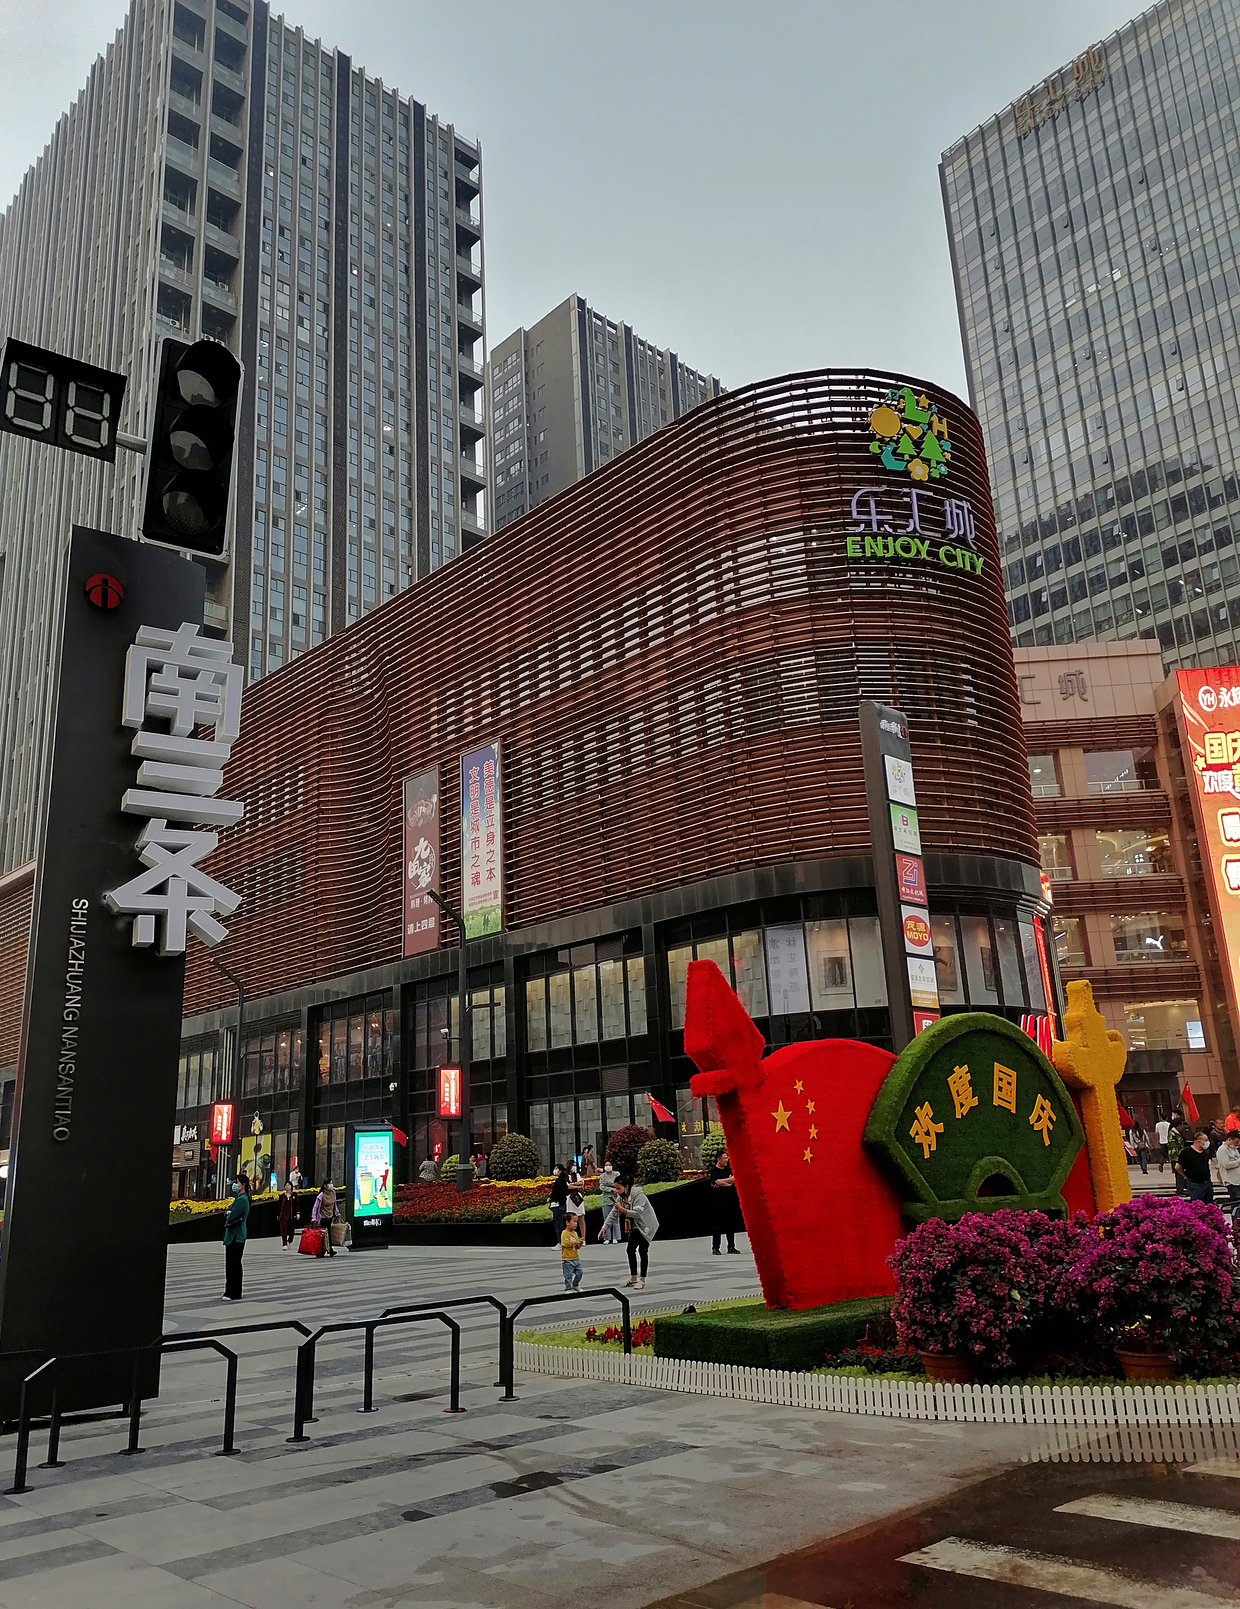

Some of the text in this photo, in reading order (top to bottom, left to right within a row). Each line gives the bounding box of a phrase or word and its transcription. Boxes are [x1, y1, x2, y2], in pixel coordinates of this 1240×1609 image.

[846, 535, 984, 576] ENJOY CITY
[850, 485, 977, 550] 乐汇城
[107, 622, 244, 957] 南三条
[468, 765, 481, 887] 文明是城市之魂
[483, 758, 496, 883] 美德是立身之本
[407, 917, 436, 935] 请上四层
[906, 930, 929, 942] MOYO
[52, 897, 89, 1143] SHIJIAZHUANG NANSANTIAO
